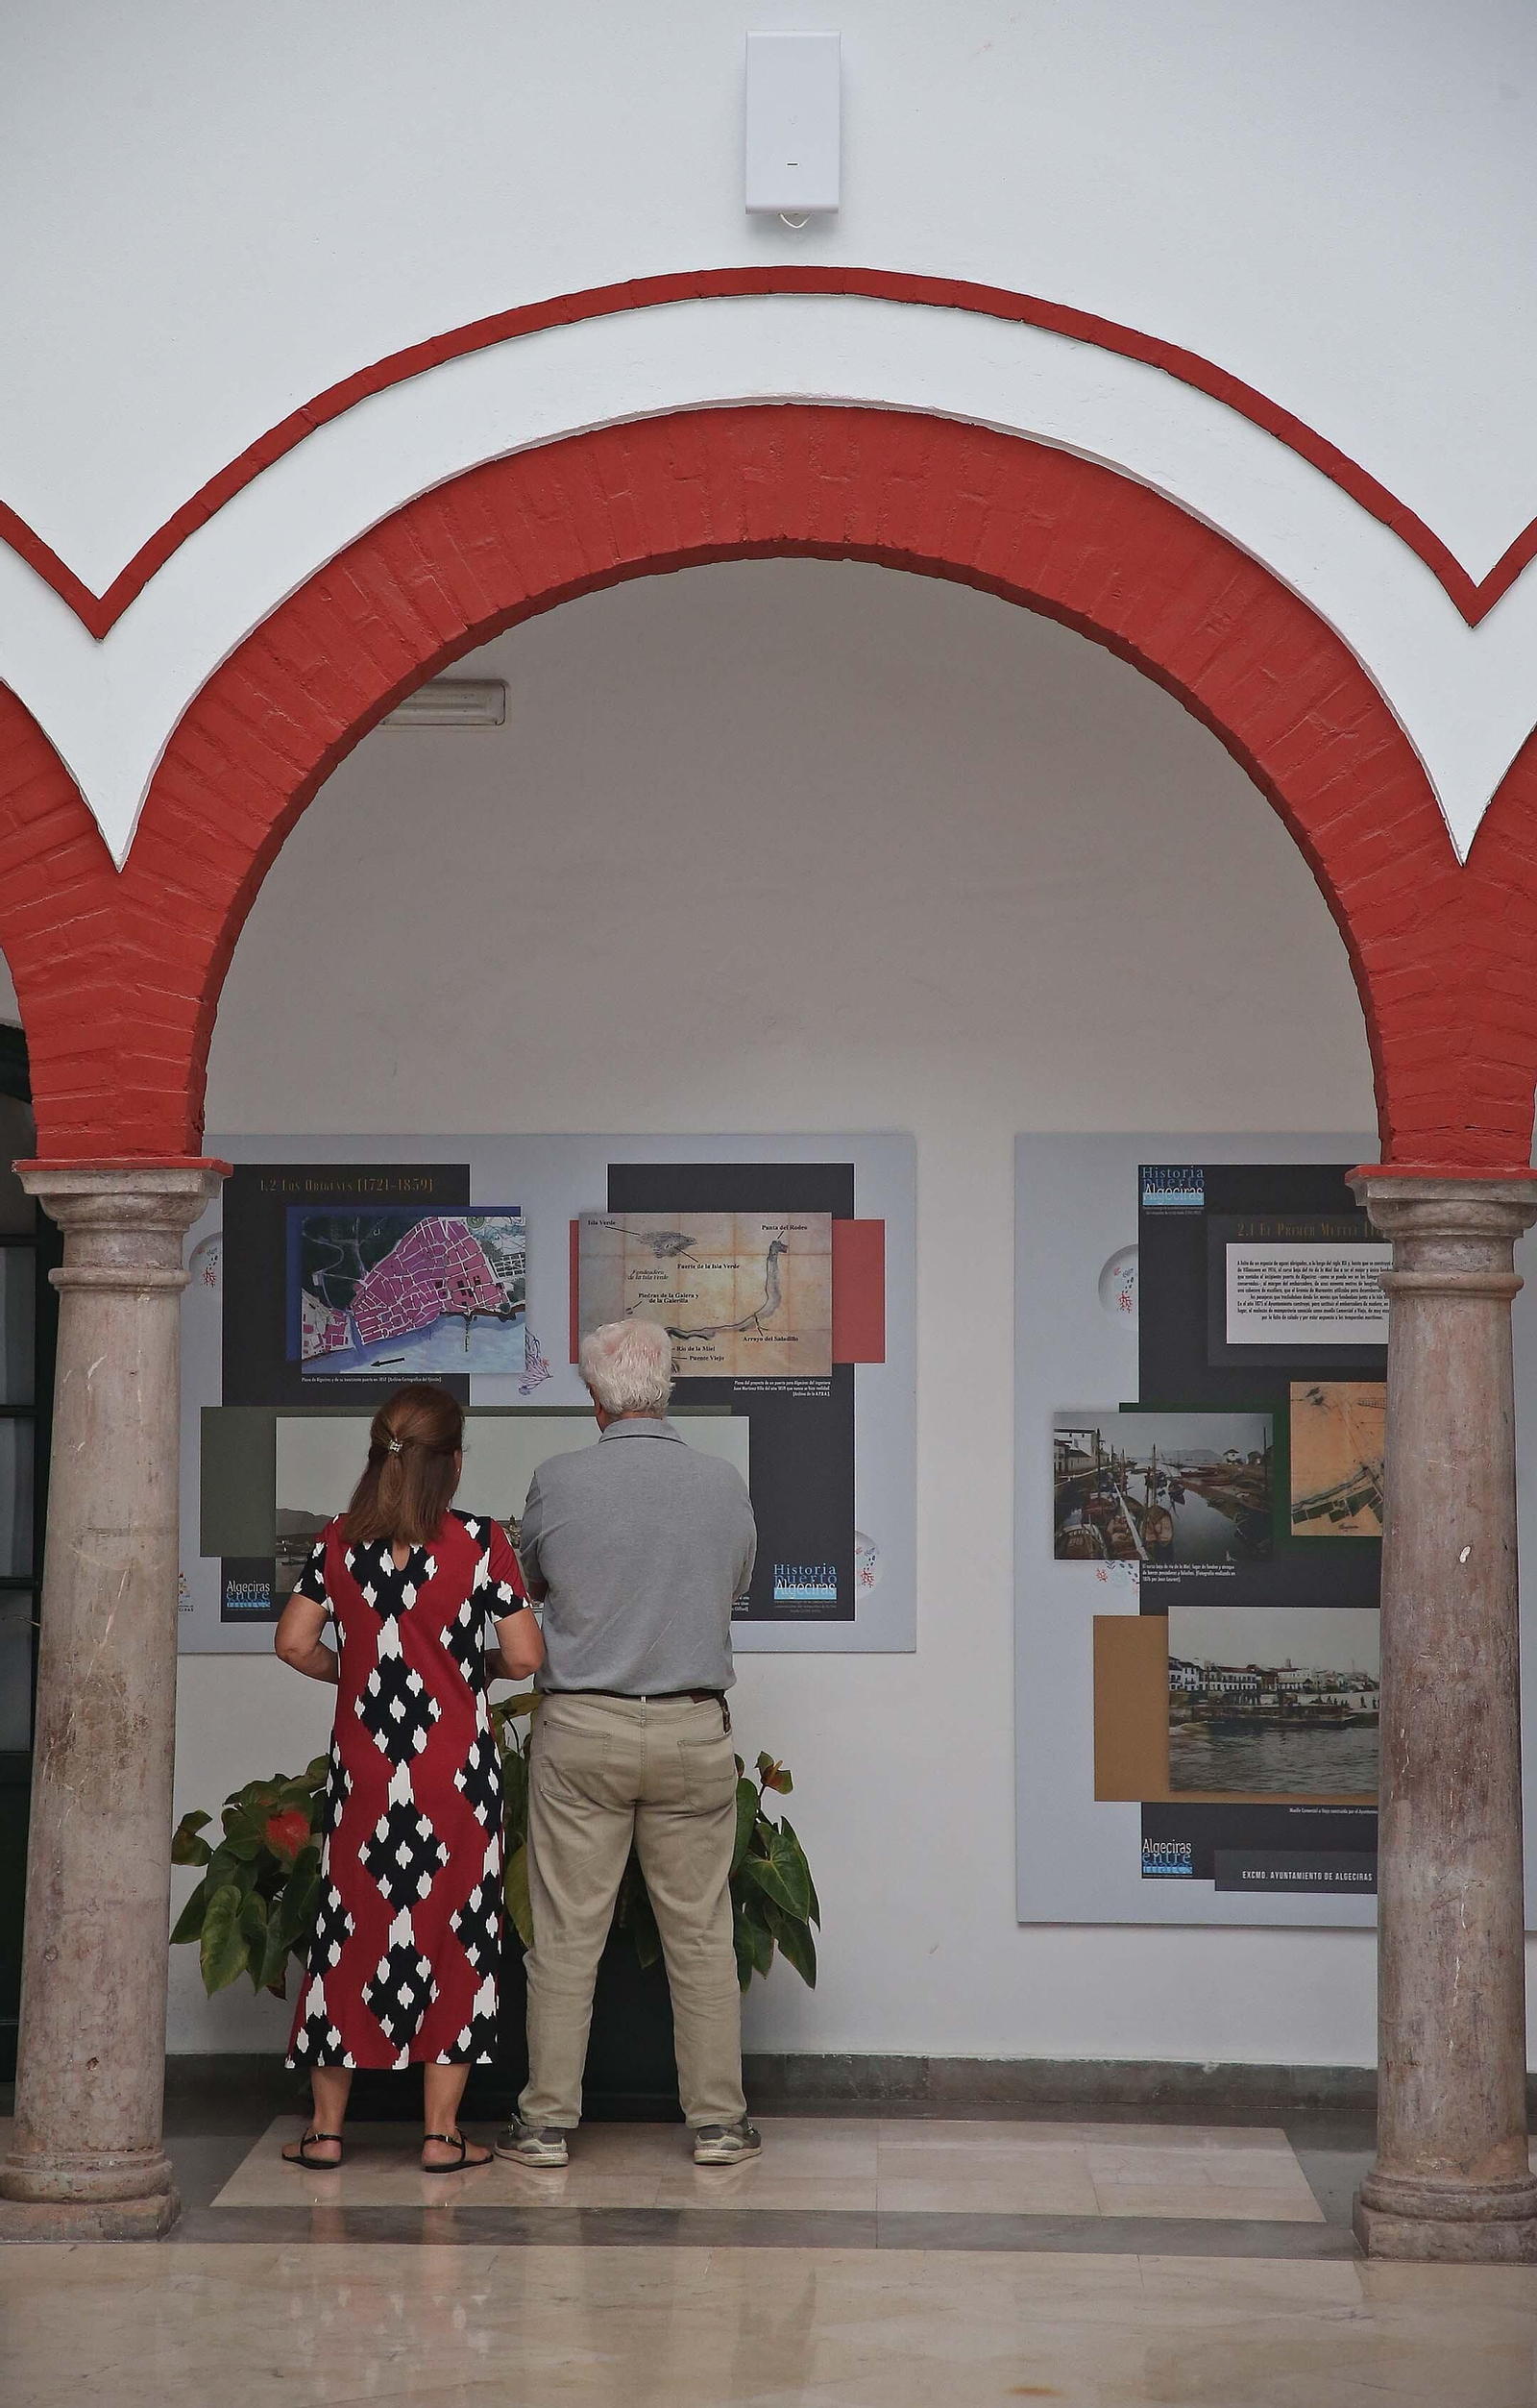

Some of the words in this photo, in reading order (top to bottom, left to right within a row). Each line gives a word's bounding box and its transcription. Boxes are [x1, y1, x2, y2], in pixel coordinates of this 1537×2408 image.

[1143, 1166, 1204, 1178] Historia
[774, 1562, 837, 1575] Historia
[226, 1580, 270, 1593] Algeciras
[774, 1578, 837, 1599] Algeciras
[1142, 1838, 1192, 1857] Algeciras
[1143, 1853, 1191, 1864] entre
[1242, 1871, 1268, 1880] EXCMO.
[1270, 1871, 1322, 1880] AYUNTAMIENTO
[1324, 1872, 1333, 1880] DE
[1334, 1872, 1373, 1881] ALGECIRAS
